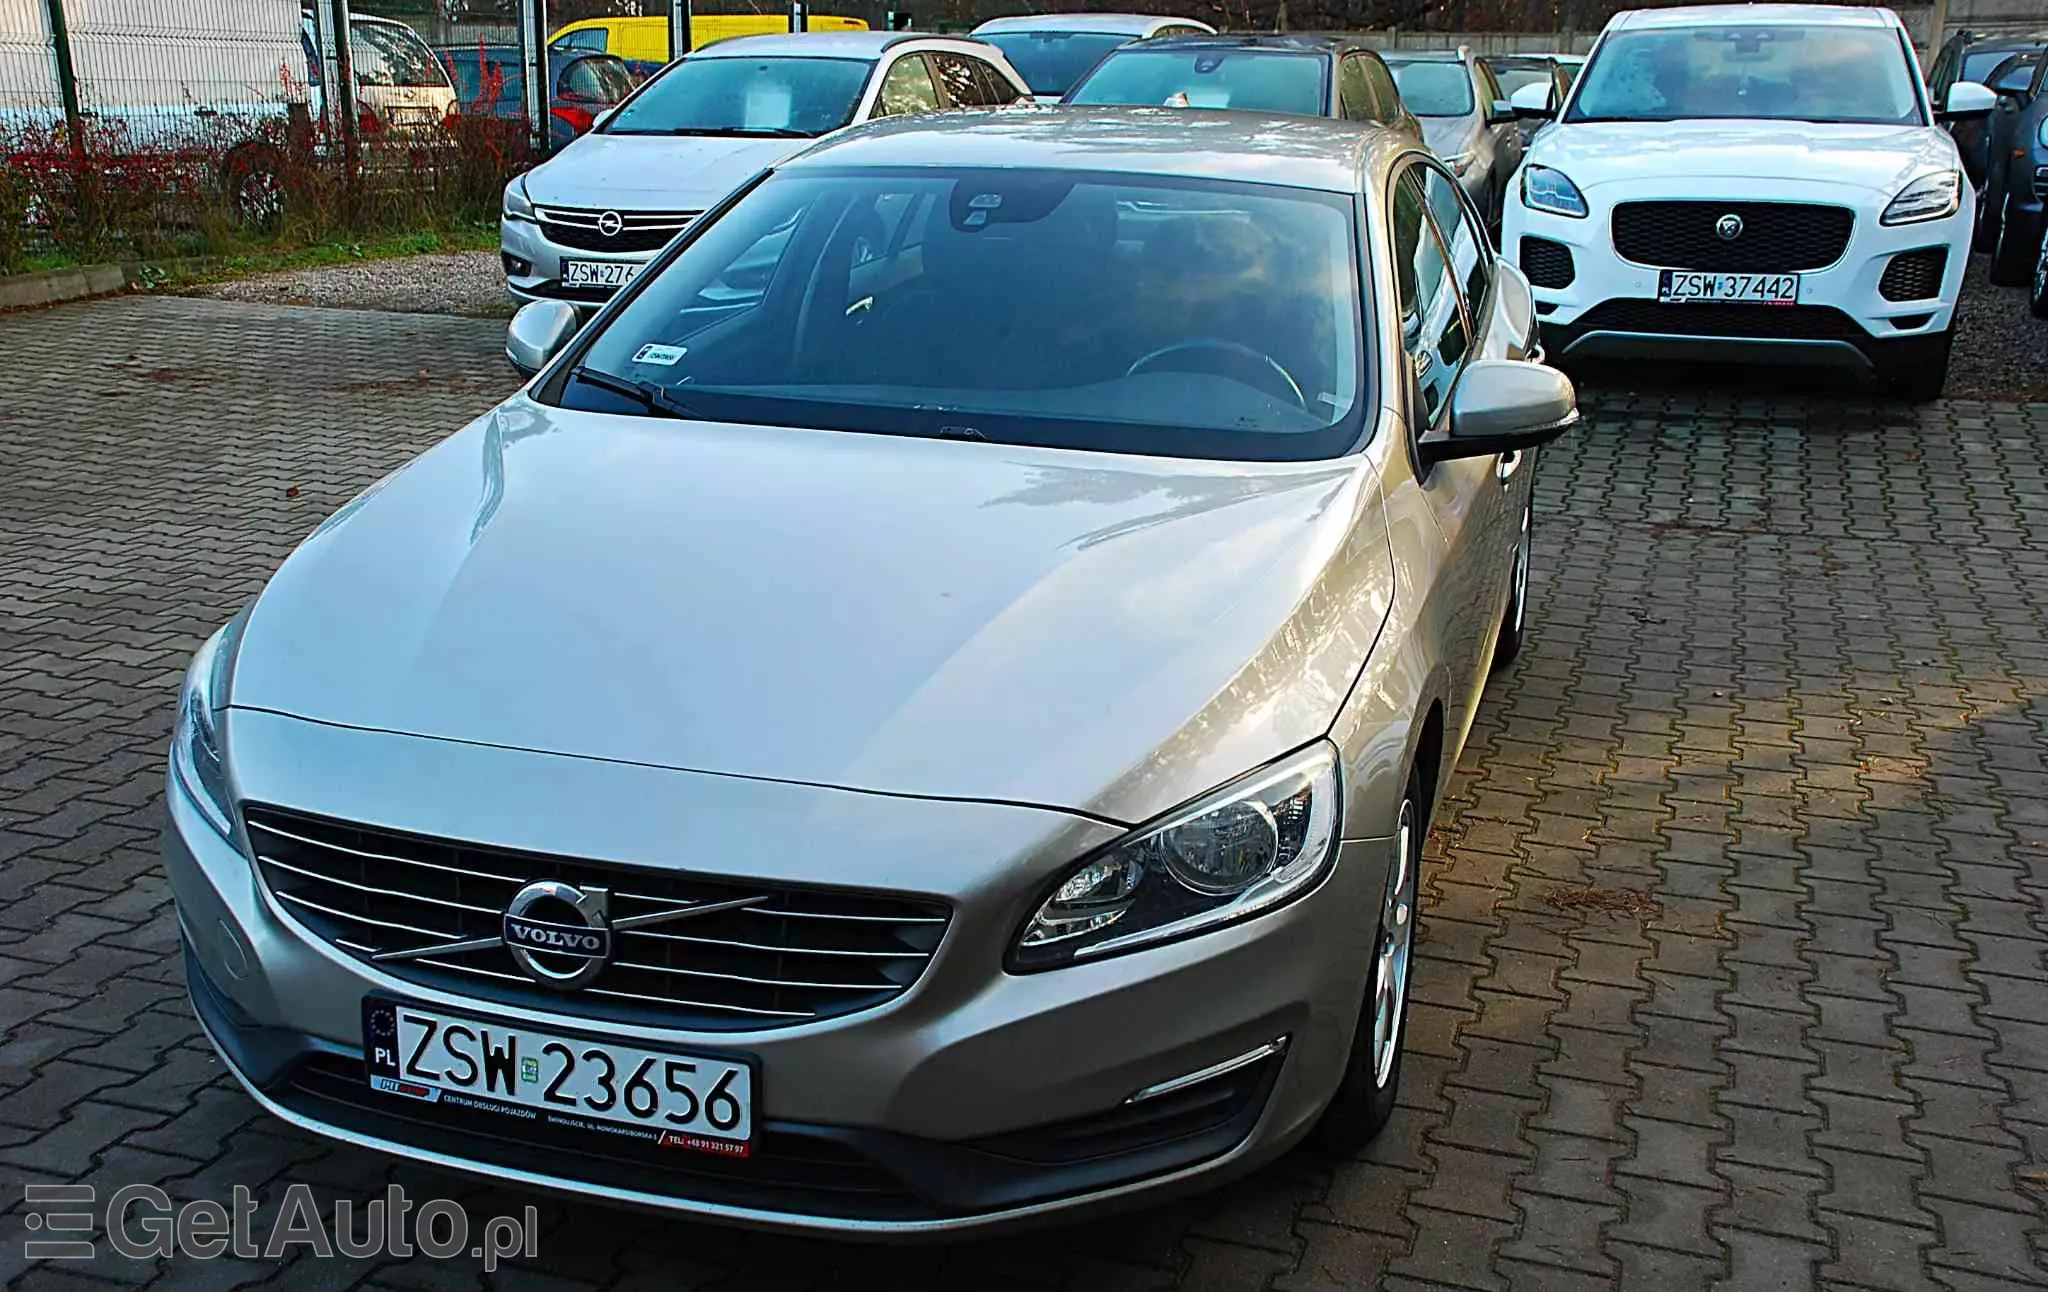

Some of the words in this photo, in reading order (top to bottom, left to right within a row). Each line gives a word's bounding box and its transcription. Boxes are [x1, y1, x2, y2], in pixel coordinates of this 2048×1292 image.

[570, 263, 599, 282] ZSW
[1673, 274, 1716, 297] ZSW
[1724, 275, 1794, 299] 37442
[510, 923, 600, 950] VOLVO
[375, 1047, 396, 1067] PL
[402, 1014, 517, 1096] ZSW
[541, 1042, 742, 1131] 23656
